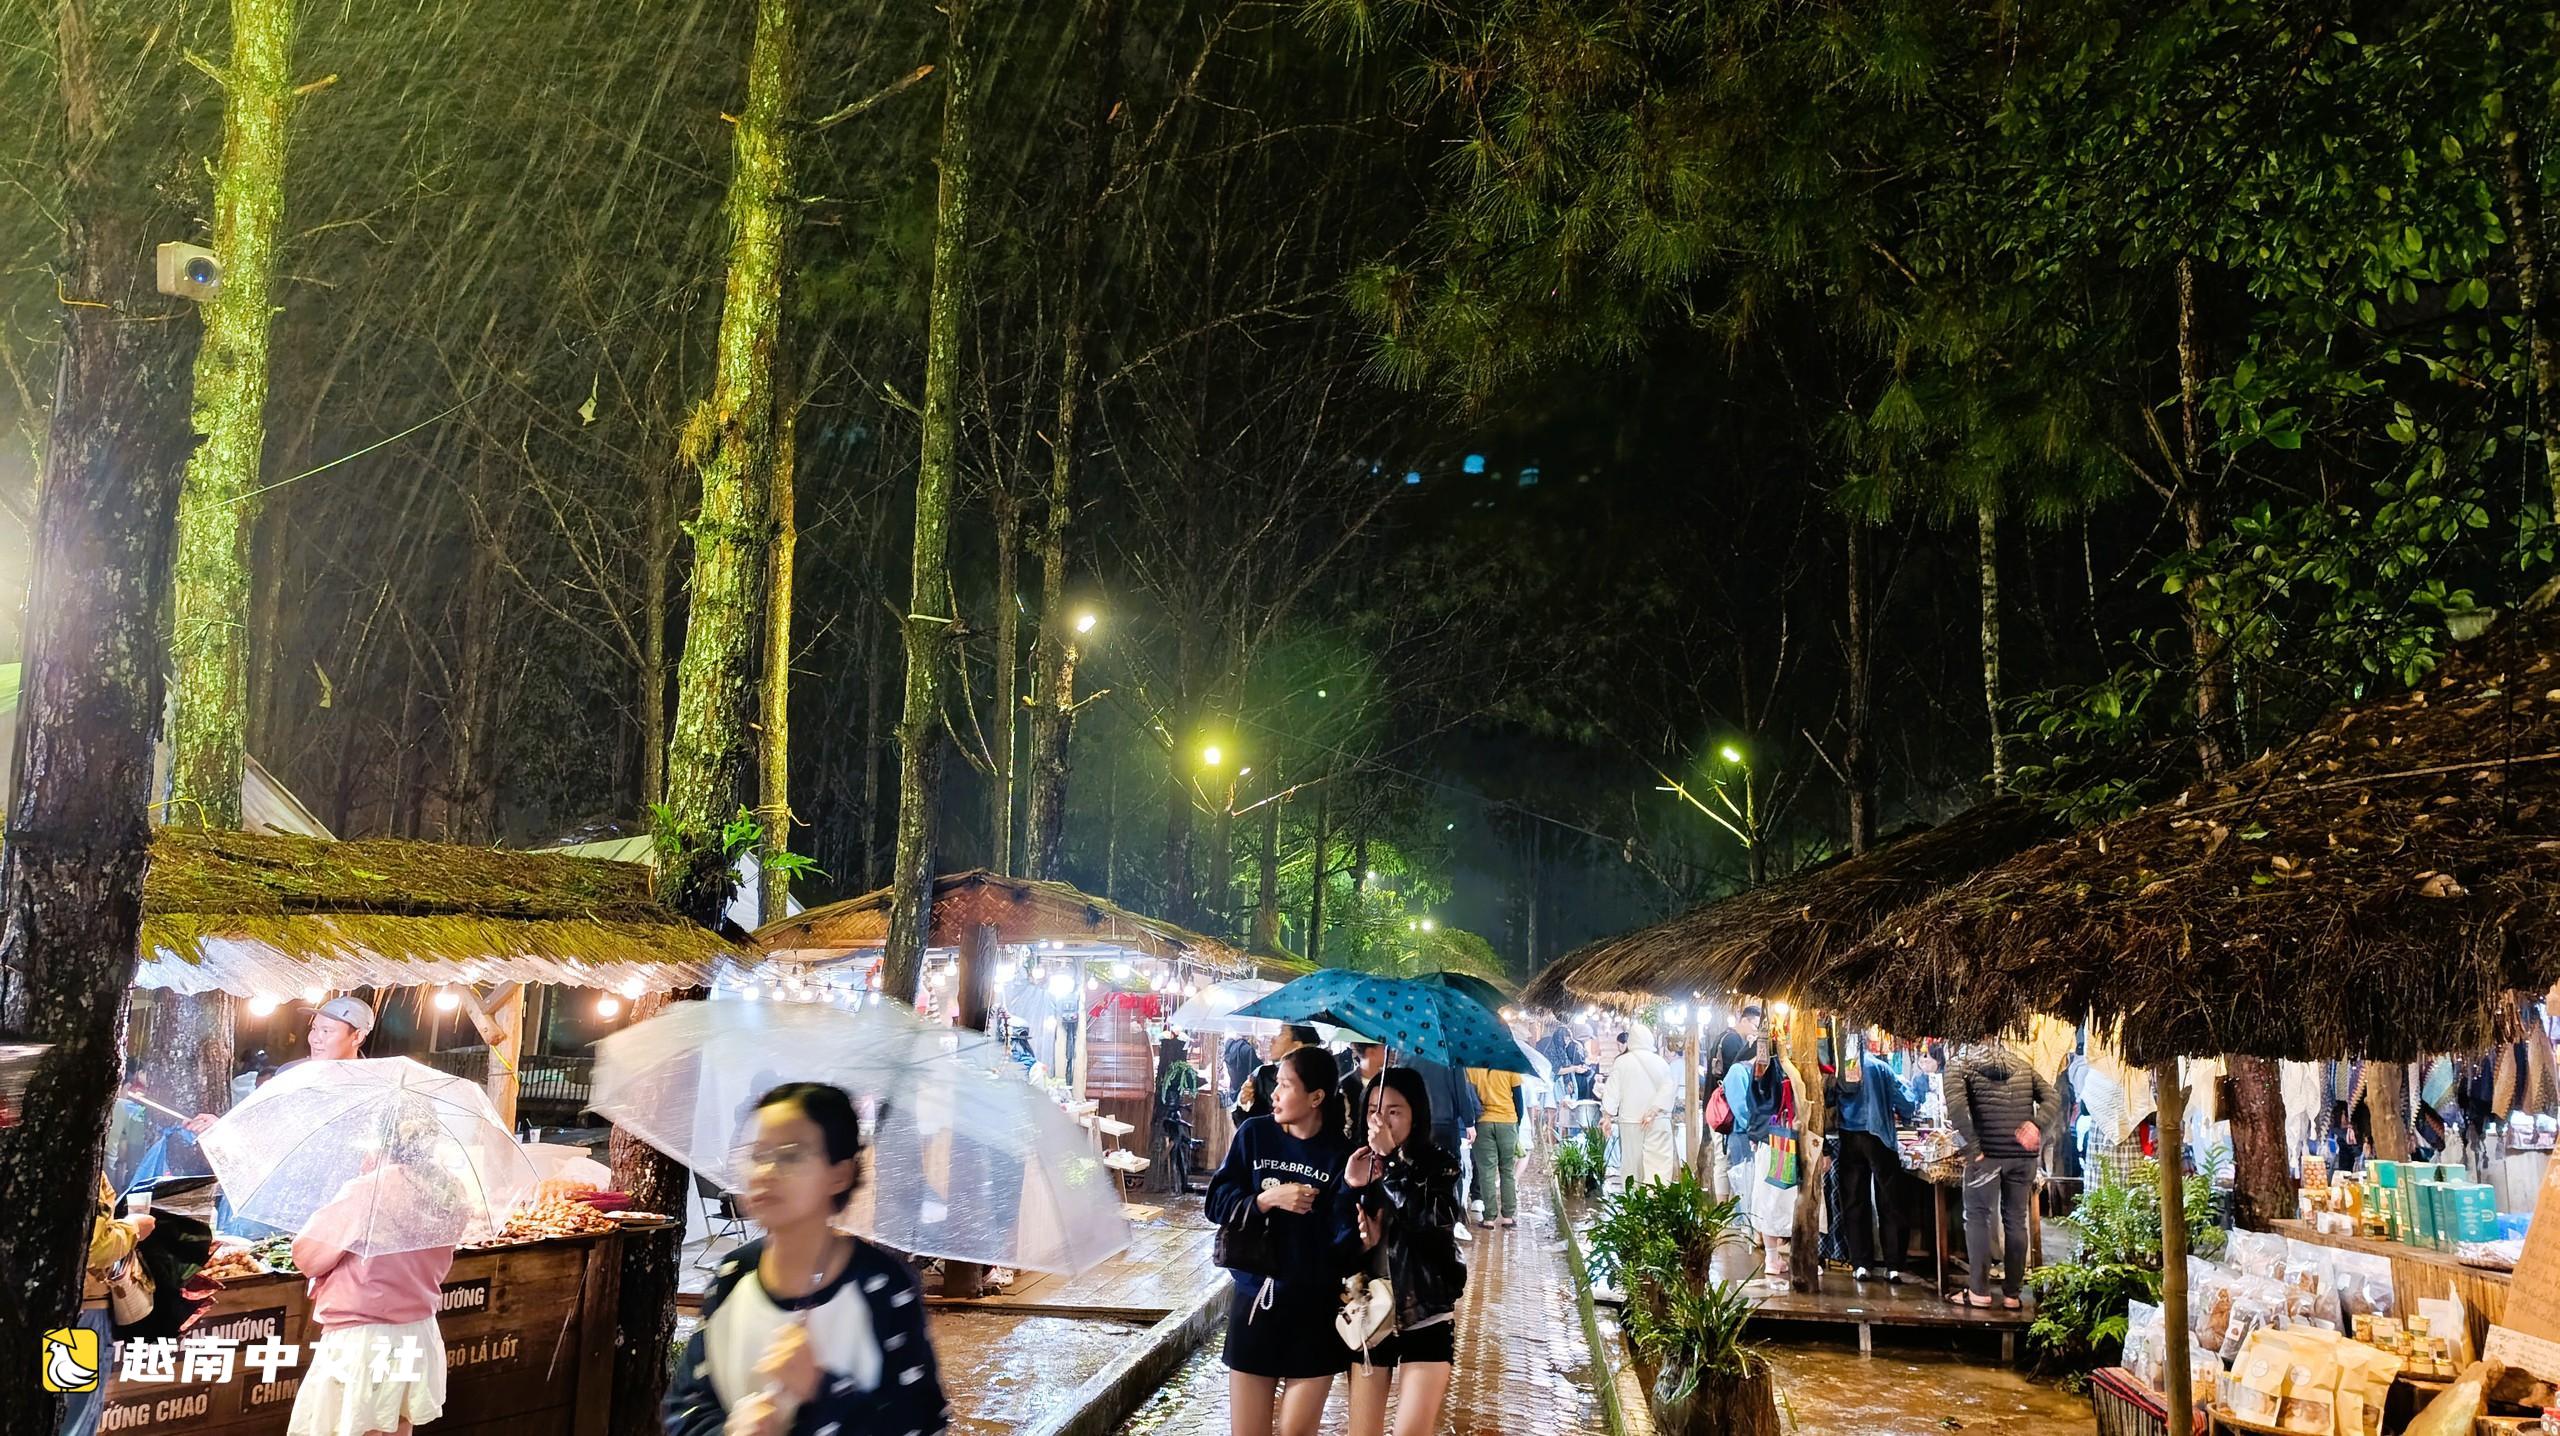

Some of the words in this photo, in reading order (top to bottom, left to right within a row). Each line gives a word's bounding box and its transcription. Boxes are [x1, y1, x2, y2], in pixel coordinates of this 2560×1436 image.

[1253, 1159, 1330, 1183] LIFE&BREAD
[250, 1377, 299, 1405] CHIM
[156, 1393, 208, 1422] CHAO
